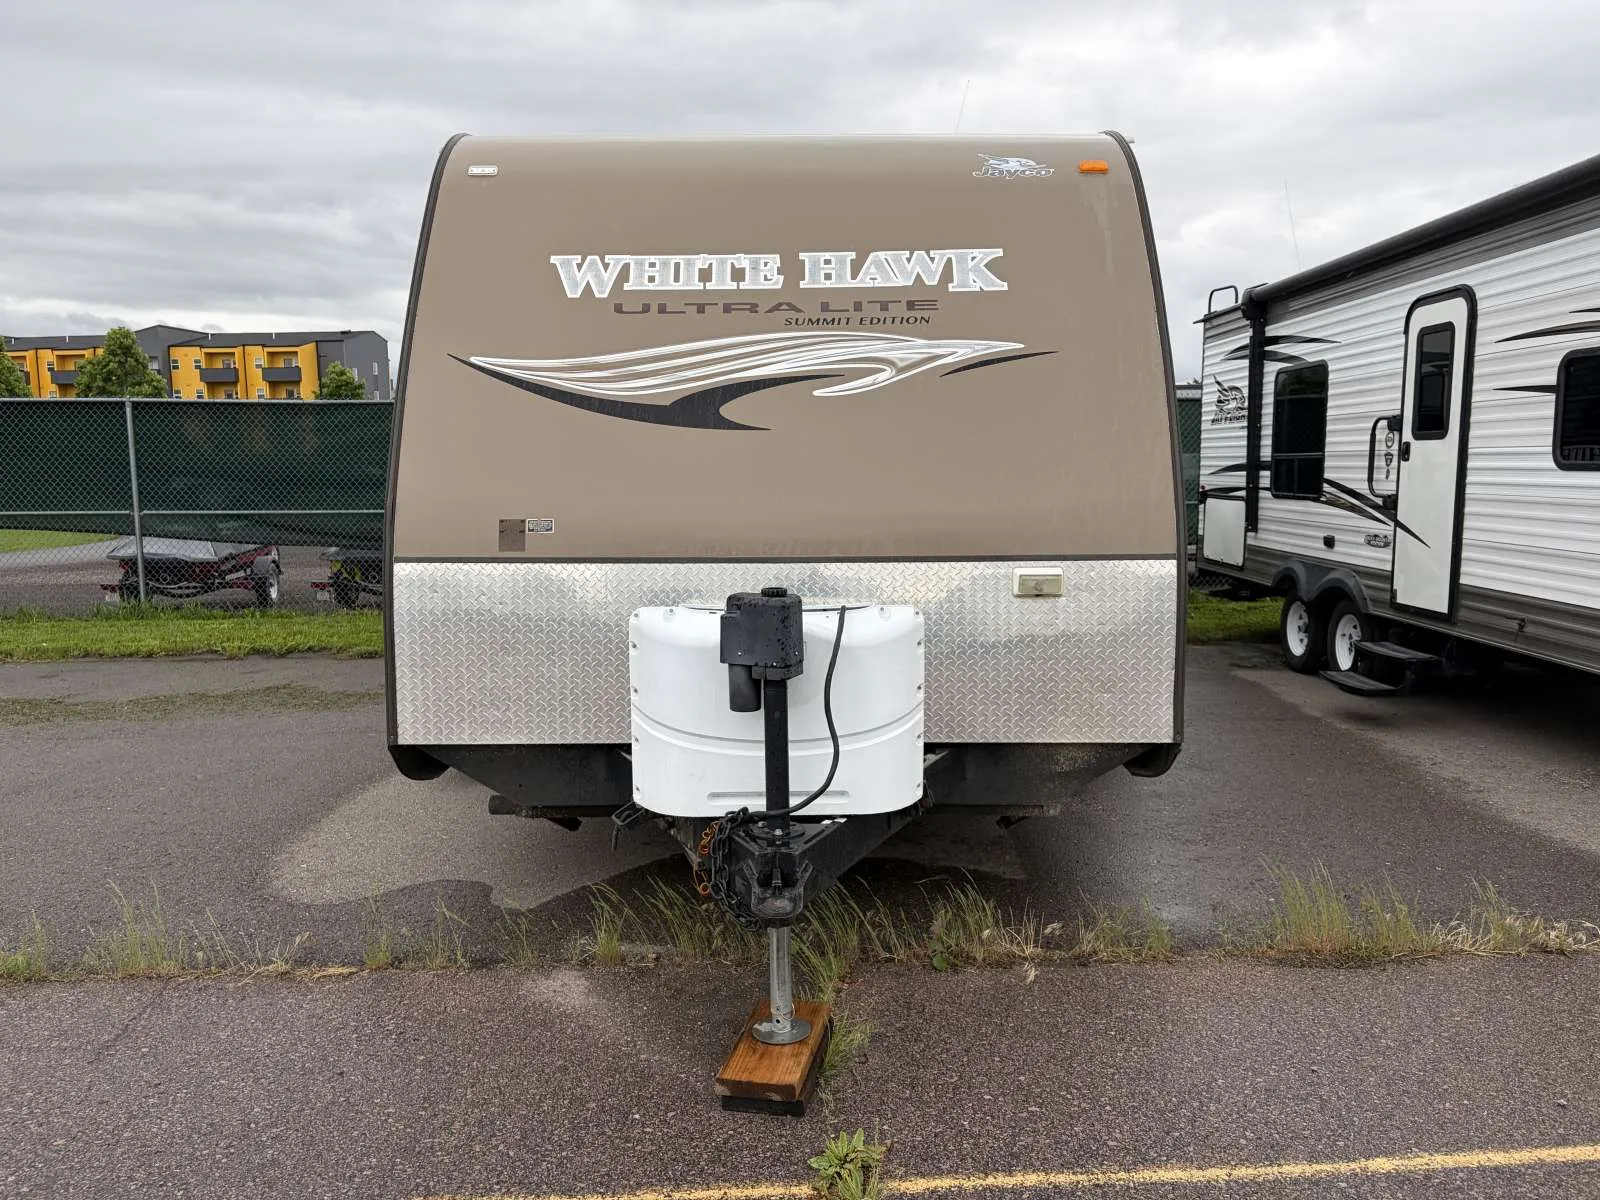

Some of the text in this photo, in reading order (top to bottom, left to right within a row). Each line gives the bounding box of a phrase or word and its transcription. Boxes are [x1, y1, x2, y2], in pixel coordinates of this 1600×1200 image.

[972, 166, 1054, 179] Jayco
[551, 249, 1008, 298] WHITE HAWK
[613, 300, 939, 314] ULTRA LITE
[783, 315, 931, 327] SUMMIT EDITION
